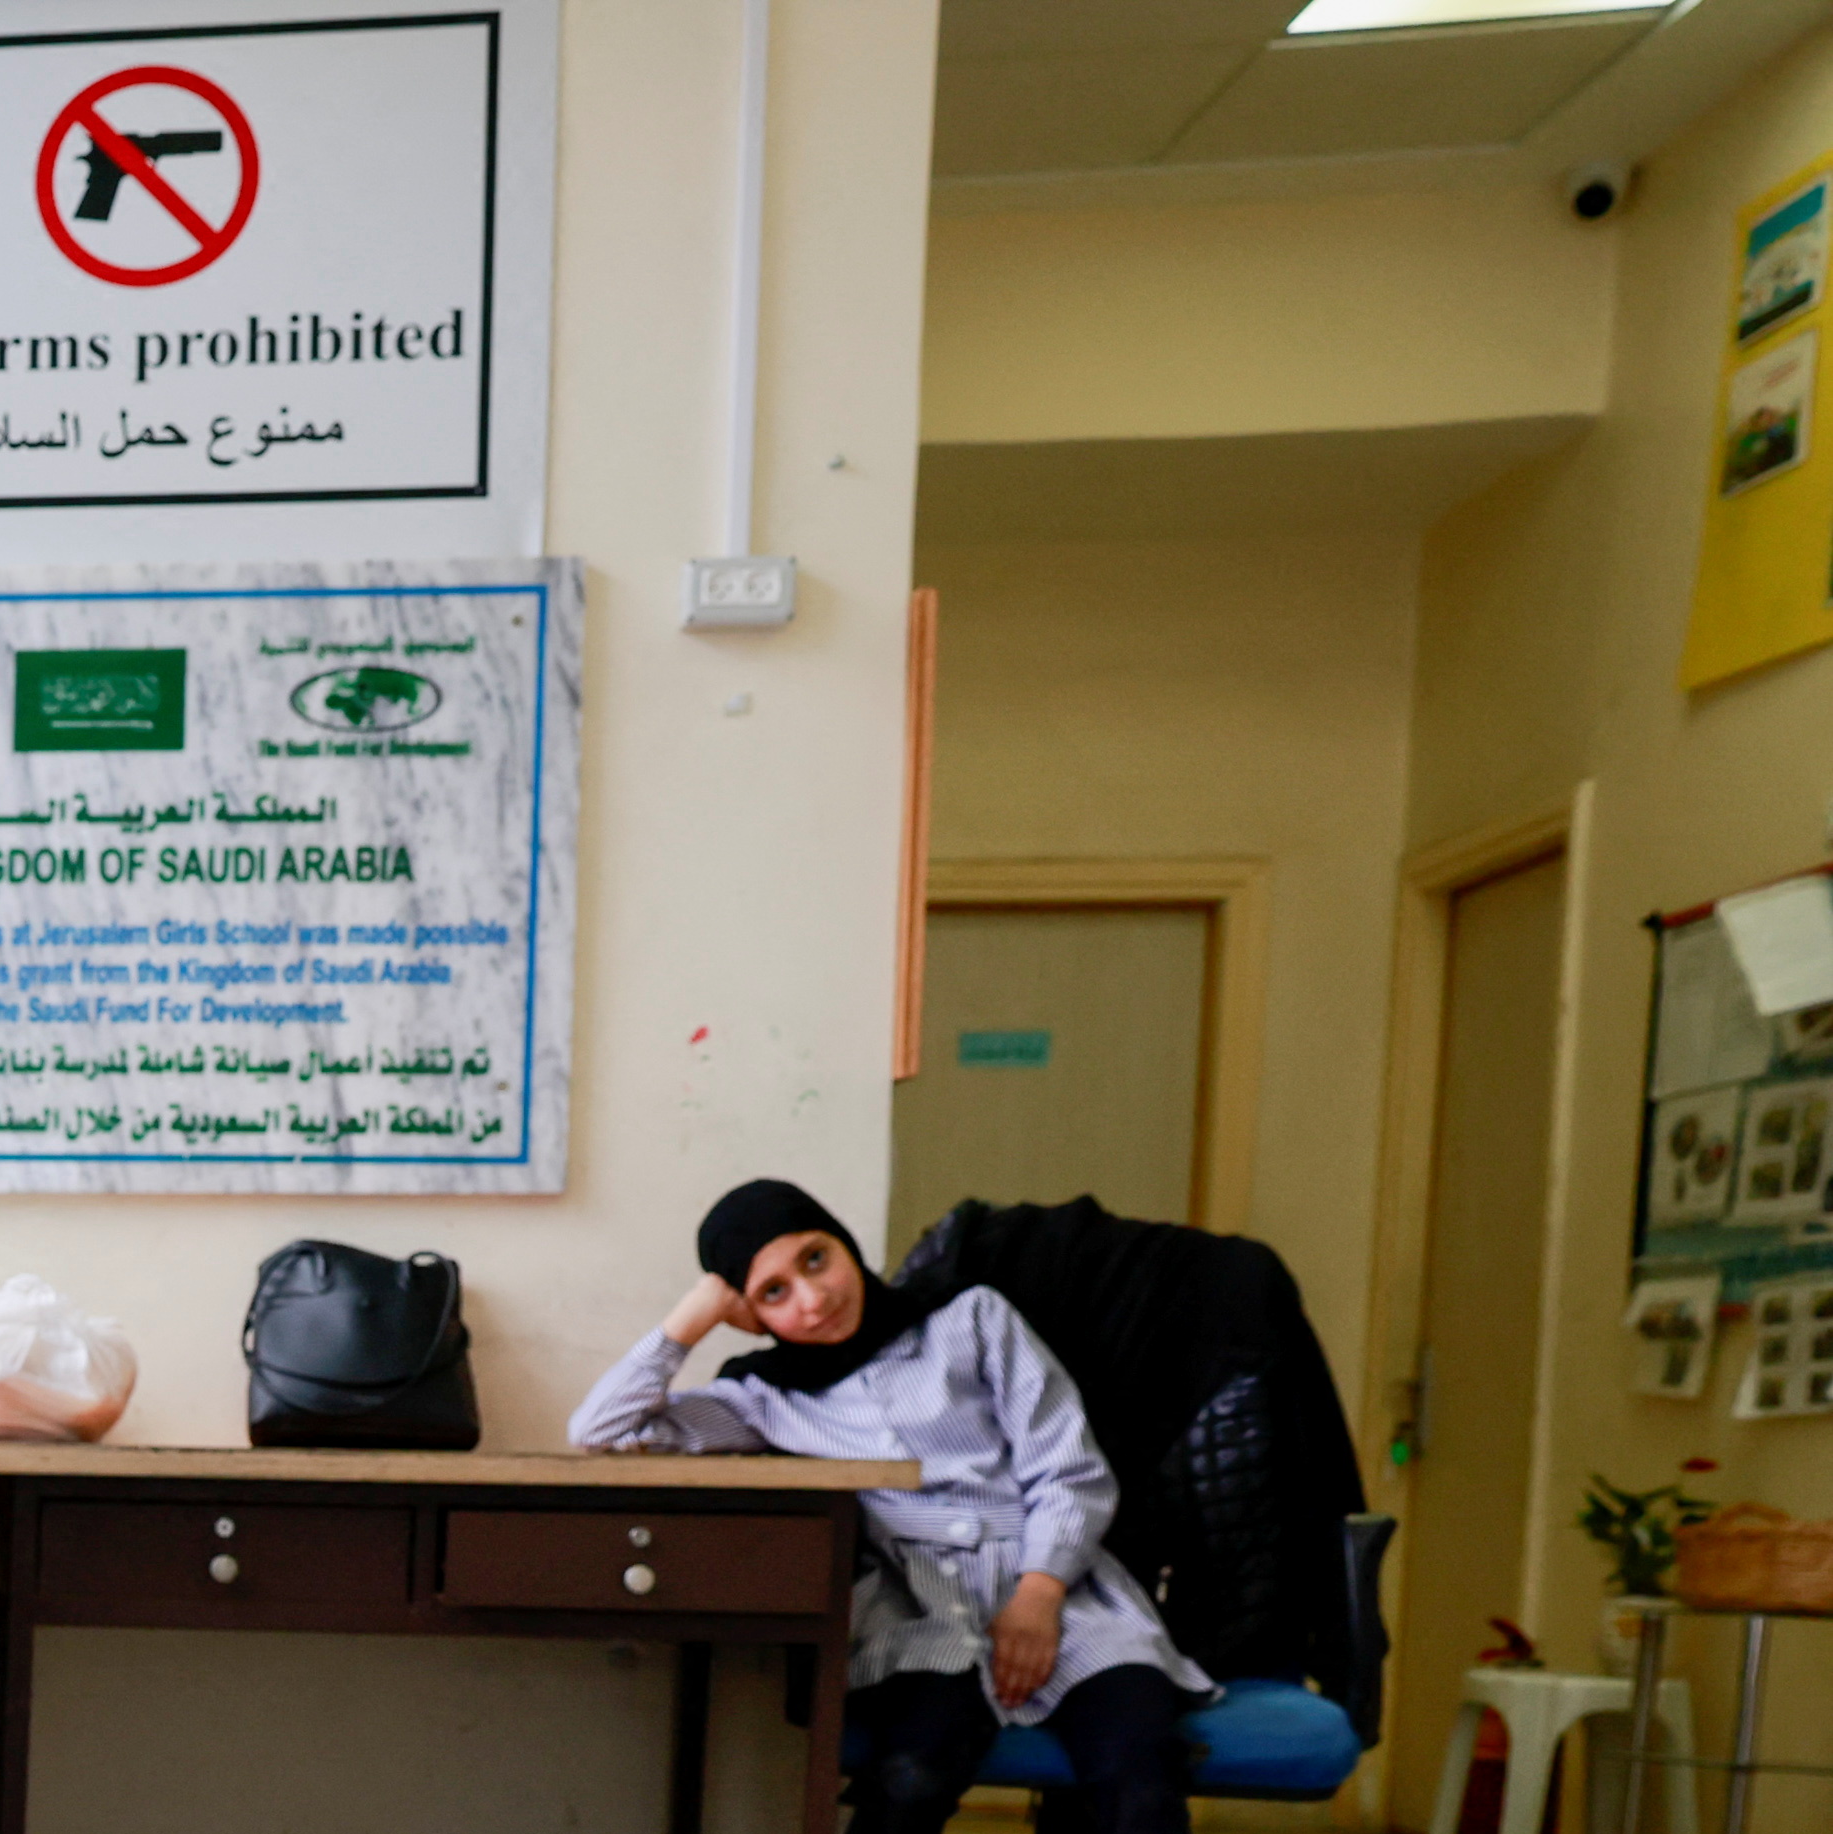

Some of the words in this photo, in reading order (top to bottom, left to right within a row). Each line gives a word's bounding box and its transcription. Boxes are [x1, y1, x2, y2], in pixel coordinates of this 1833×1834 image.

[135, 309, 464, 383] prohibited
[100, 410, 190, 459] حمل
[208, 407, 345, 468] ممنوع
[75, 793, 206, 833] العربية
[213, 793, 337, 824] المملكة
[99, 847, 146, 884] OF
[157, 847, 266, 884] SAUDI
[275, 846, 415, 883] ARABIA
[11, 923, 32, 947] at
[37, 921, 150, 947] Jerusalem
[156, 919, 209, 946] Girls
[215, 919, 292, 946] School
[298, 926, 340, 945] was
[347, 920, 409, 945] made
[413, 920, 510, 950] possible
[17, 963, 74, 992] grant
[79, 959, 131, 985] from
[137, 959, 171, 985] the
[177, 959, 277, 991] Kingdom
[283, 959, 306, 985] of
[310, 957, 375, 985] Saudi
[379, 959, 452, 985] Arabia
[28, 996, 90, 1024] Saudi
[95, 996, 151, 1023] Fund
[157, 996, 194, 1024] For
[137, 1045, 205, 1075] شاملة
[213, 1045, 291, 1082] صيانة
[298, 1044, 374, 1083] أعمال
[460, 1047, 491, 1081] تم
[65, 1104, 123, 1142] خلال
[131, 1109, 162, 1143] من
[169, 1104, 280, 1145] السعودية
[288, 1104, 380, 1144] العربية
[387, 1105, 465, 1137] المملكة
[471, 1112, 503, 1144] من
